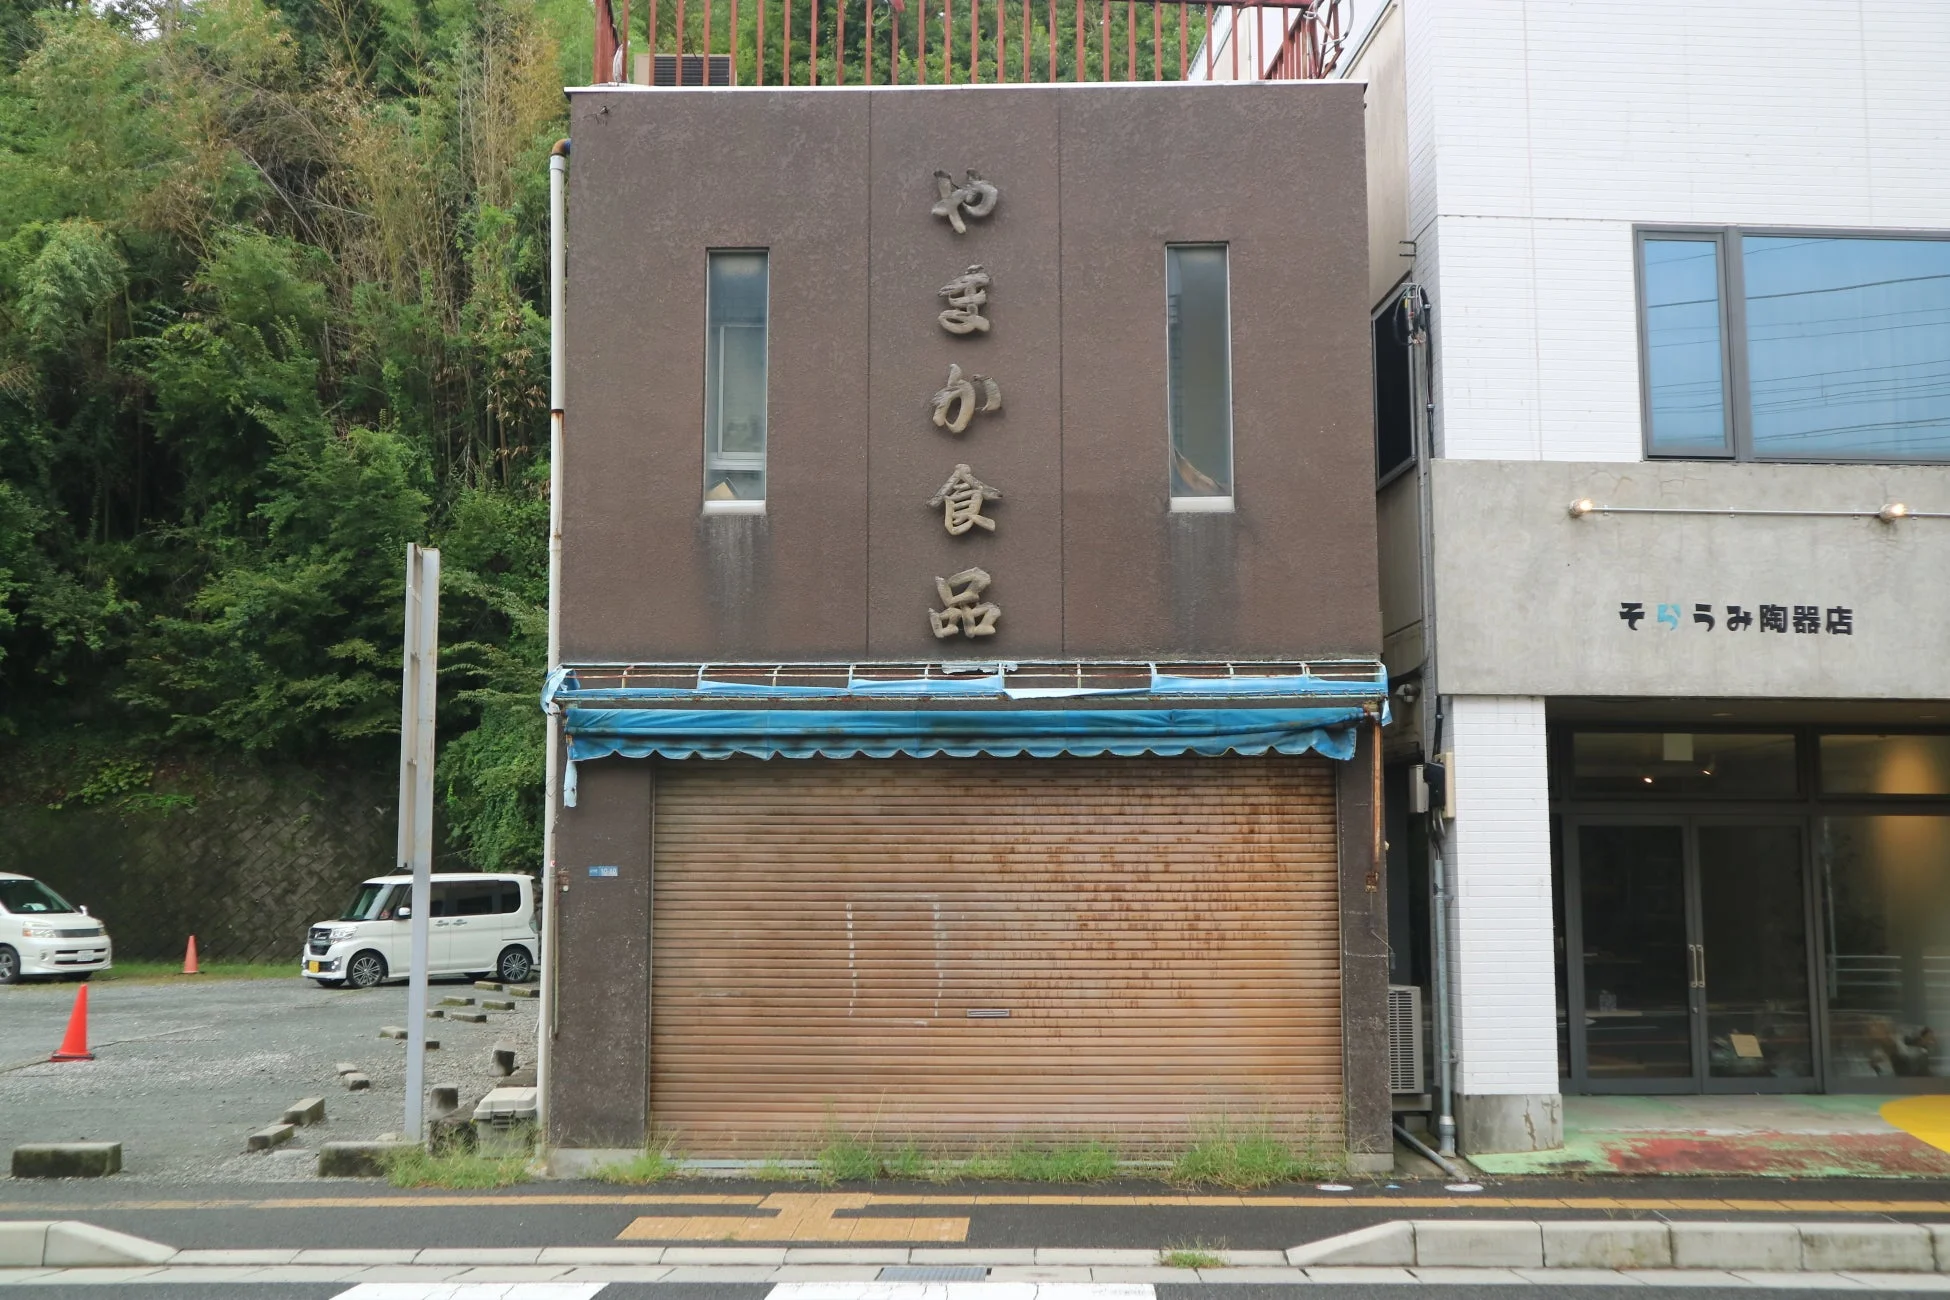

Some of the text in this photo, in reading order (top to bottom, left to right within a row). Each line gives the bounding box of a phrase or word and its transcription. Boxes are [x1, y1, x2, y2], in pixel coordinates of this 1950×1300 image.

[926, 169, 1003, 638] やまか食品
[1619, 602, 1853, 635] そらうみ陶器店
